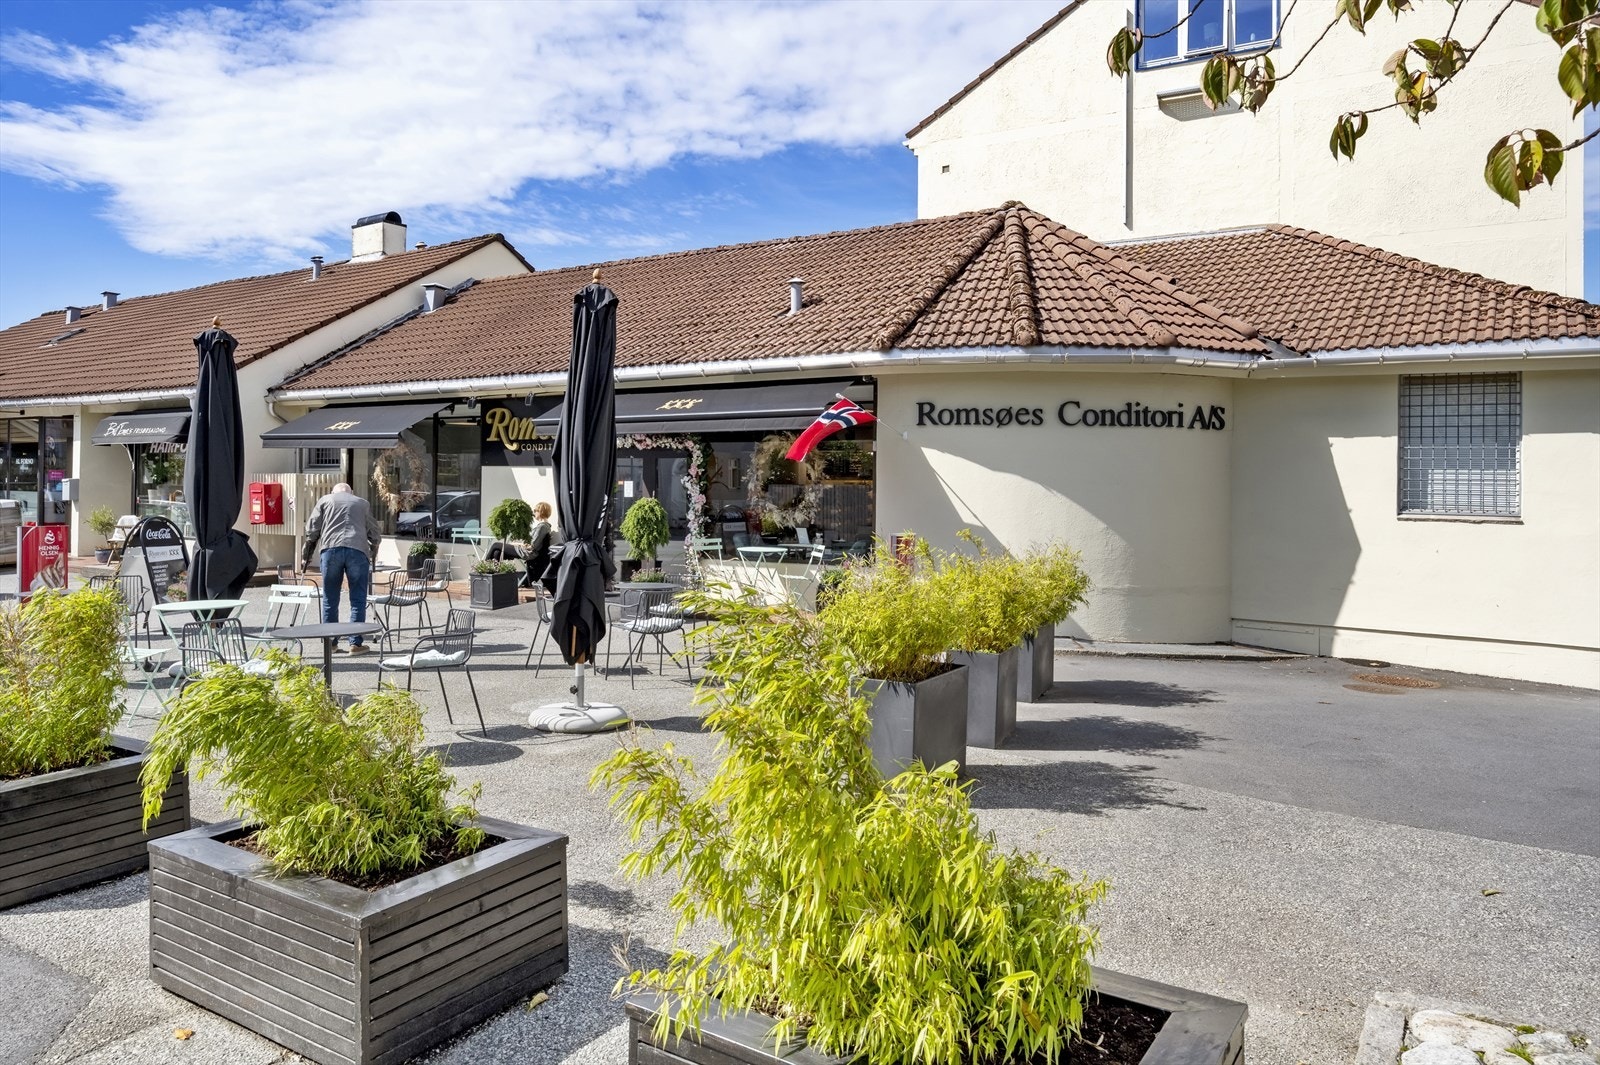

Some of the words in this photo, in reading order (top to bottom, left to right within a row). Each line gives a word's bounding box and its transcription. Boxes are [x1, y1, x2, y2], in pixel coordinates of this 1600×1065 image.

[916, 401, 1044, 428] Romsøes
[1057, 400, 1184, 428] Conditori
[1187, 405, 1226, 431] A/S
